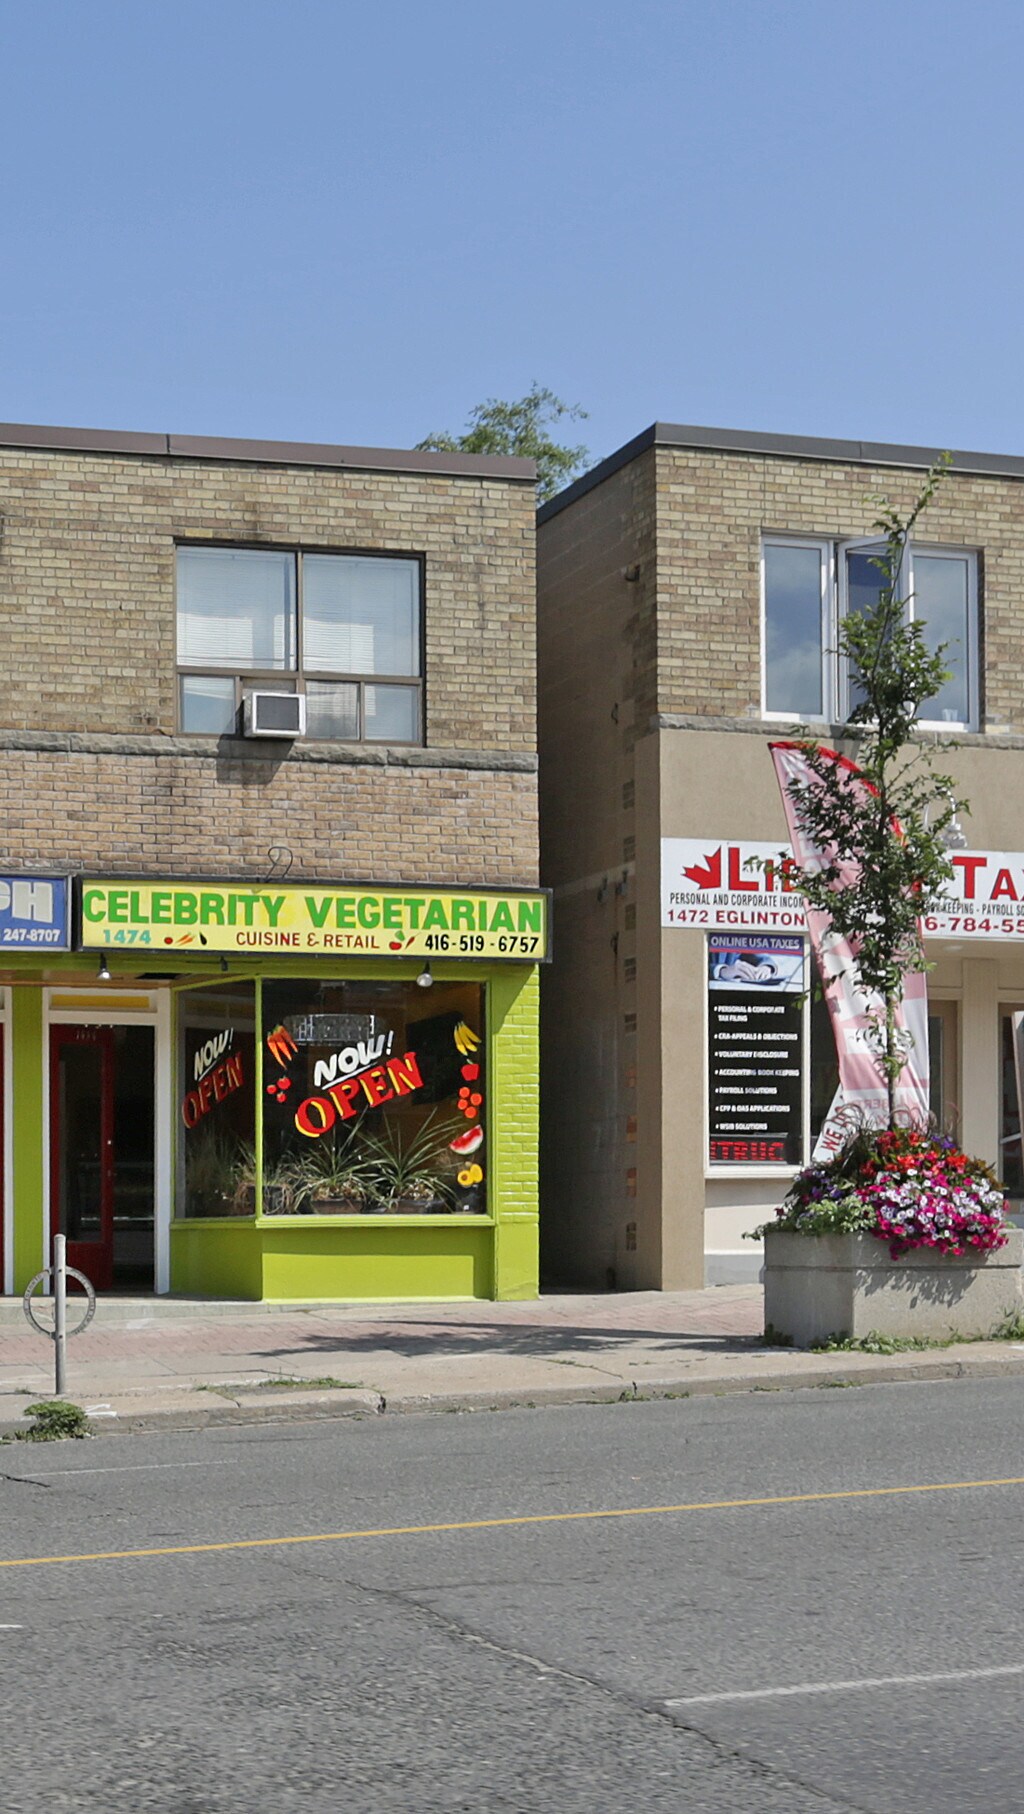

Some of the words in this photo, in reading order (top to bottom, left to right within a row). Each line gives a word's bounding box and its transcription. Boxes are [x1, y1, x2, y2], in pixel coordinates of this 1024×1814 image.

[0, 881, 53, 924] H
[670, 892, 711, 906] PERSONAL
[713, 894, 729, 907] AND
[731, 895, 777, 908] CORPORATE
[82, 889, 286, 928] CELEBRITY
[304, 896, 542, 933] VEGETARIAN
[668, 910, 709, 923] 1472
[716, 911, 805, 926] EGLINTON
[982, 903, 1014, 917] PAYROLL
[3, 928, 61, 943] 247-8707
[103, 929, 151, 945] 1474
[236, 931, 300, 947] CUISINE
[307, 933, 319, 947] &
[323, 934, 380, 949] RETAIL
[711, 936, 747, 948] ONLINE
[748, 938, 768, 949] USA
[769, 939, 800, 950] TAXES
[193, 1027, 234, 1081] NOW!
[314, 1030, 394, 1087] NOW!
[182, 1052, 245, 1129] OPEN
[295, 1052, 424, 1138] OPEN
